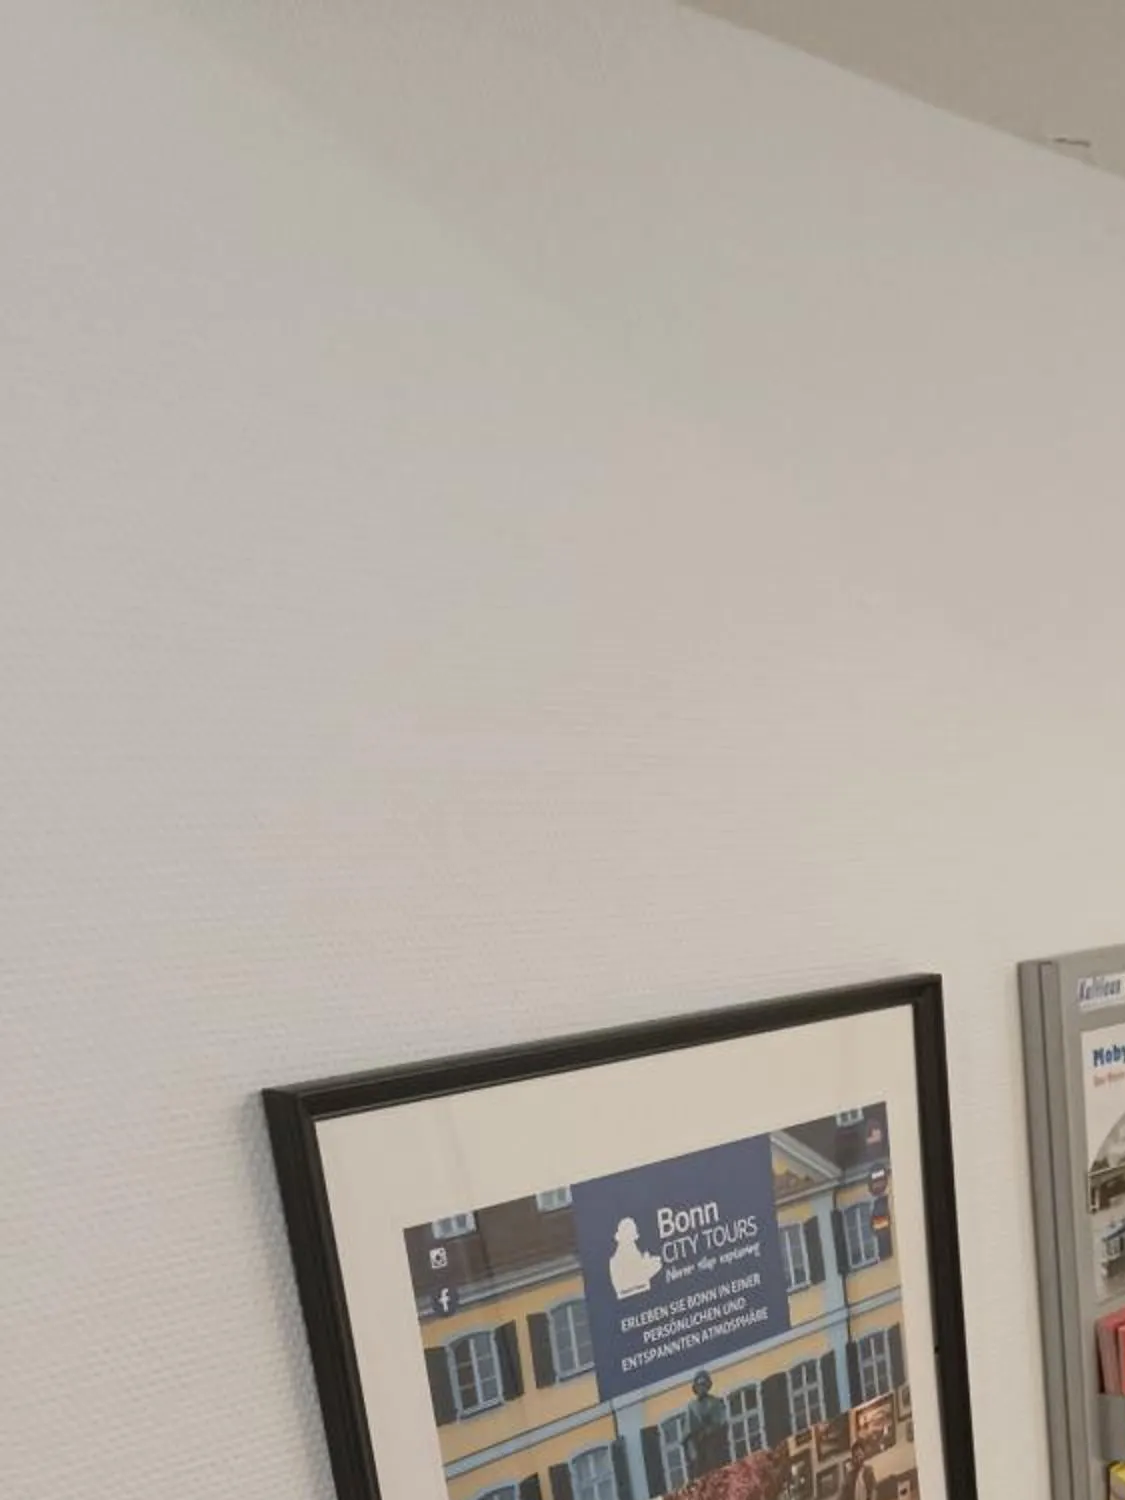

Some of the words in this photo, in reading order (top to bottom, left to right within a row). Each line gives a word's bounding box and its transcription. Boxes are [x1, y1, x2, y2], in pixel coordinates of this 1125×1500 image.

[657, 1201, 719, 1239] Bonn
[661, 1234, 699, 1263] CITY
[702, 1215, 759, 1248] TOURS
[620, 1303, 669, 1333] ERLEBEN
[669, 1299, 688, 1316] SIE
[687, 1288, 718, 1312] BONN
[717, 1283, 731, 1298] IN
[730, 1272, 761, 1294] EINER
[643, 1302, 721, 1345] PERSÖNLICHEN
[721, 1297, 746, 1315] UND
[620, 1331, 701, 1372] ENTSPANNTEN
[701, 1306, 769, 1343] ATMOSPHÄRE
